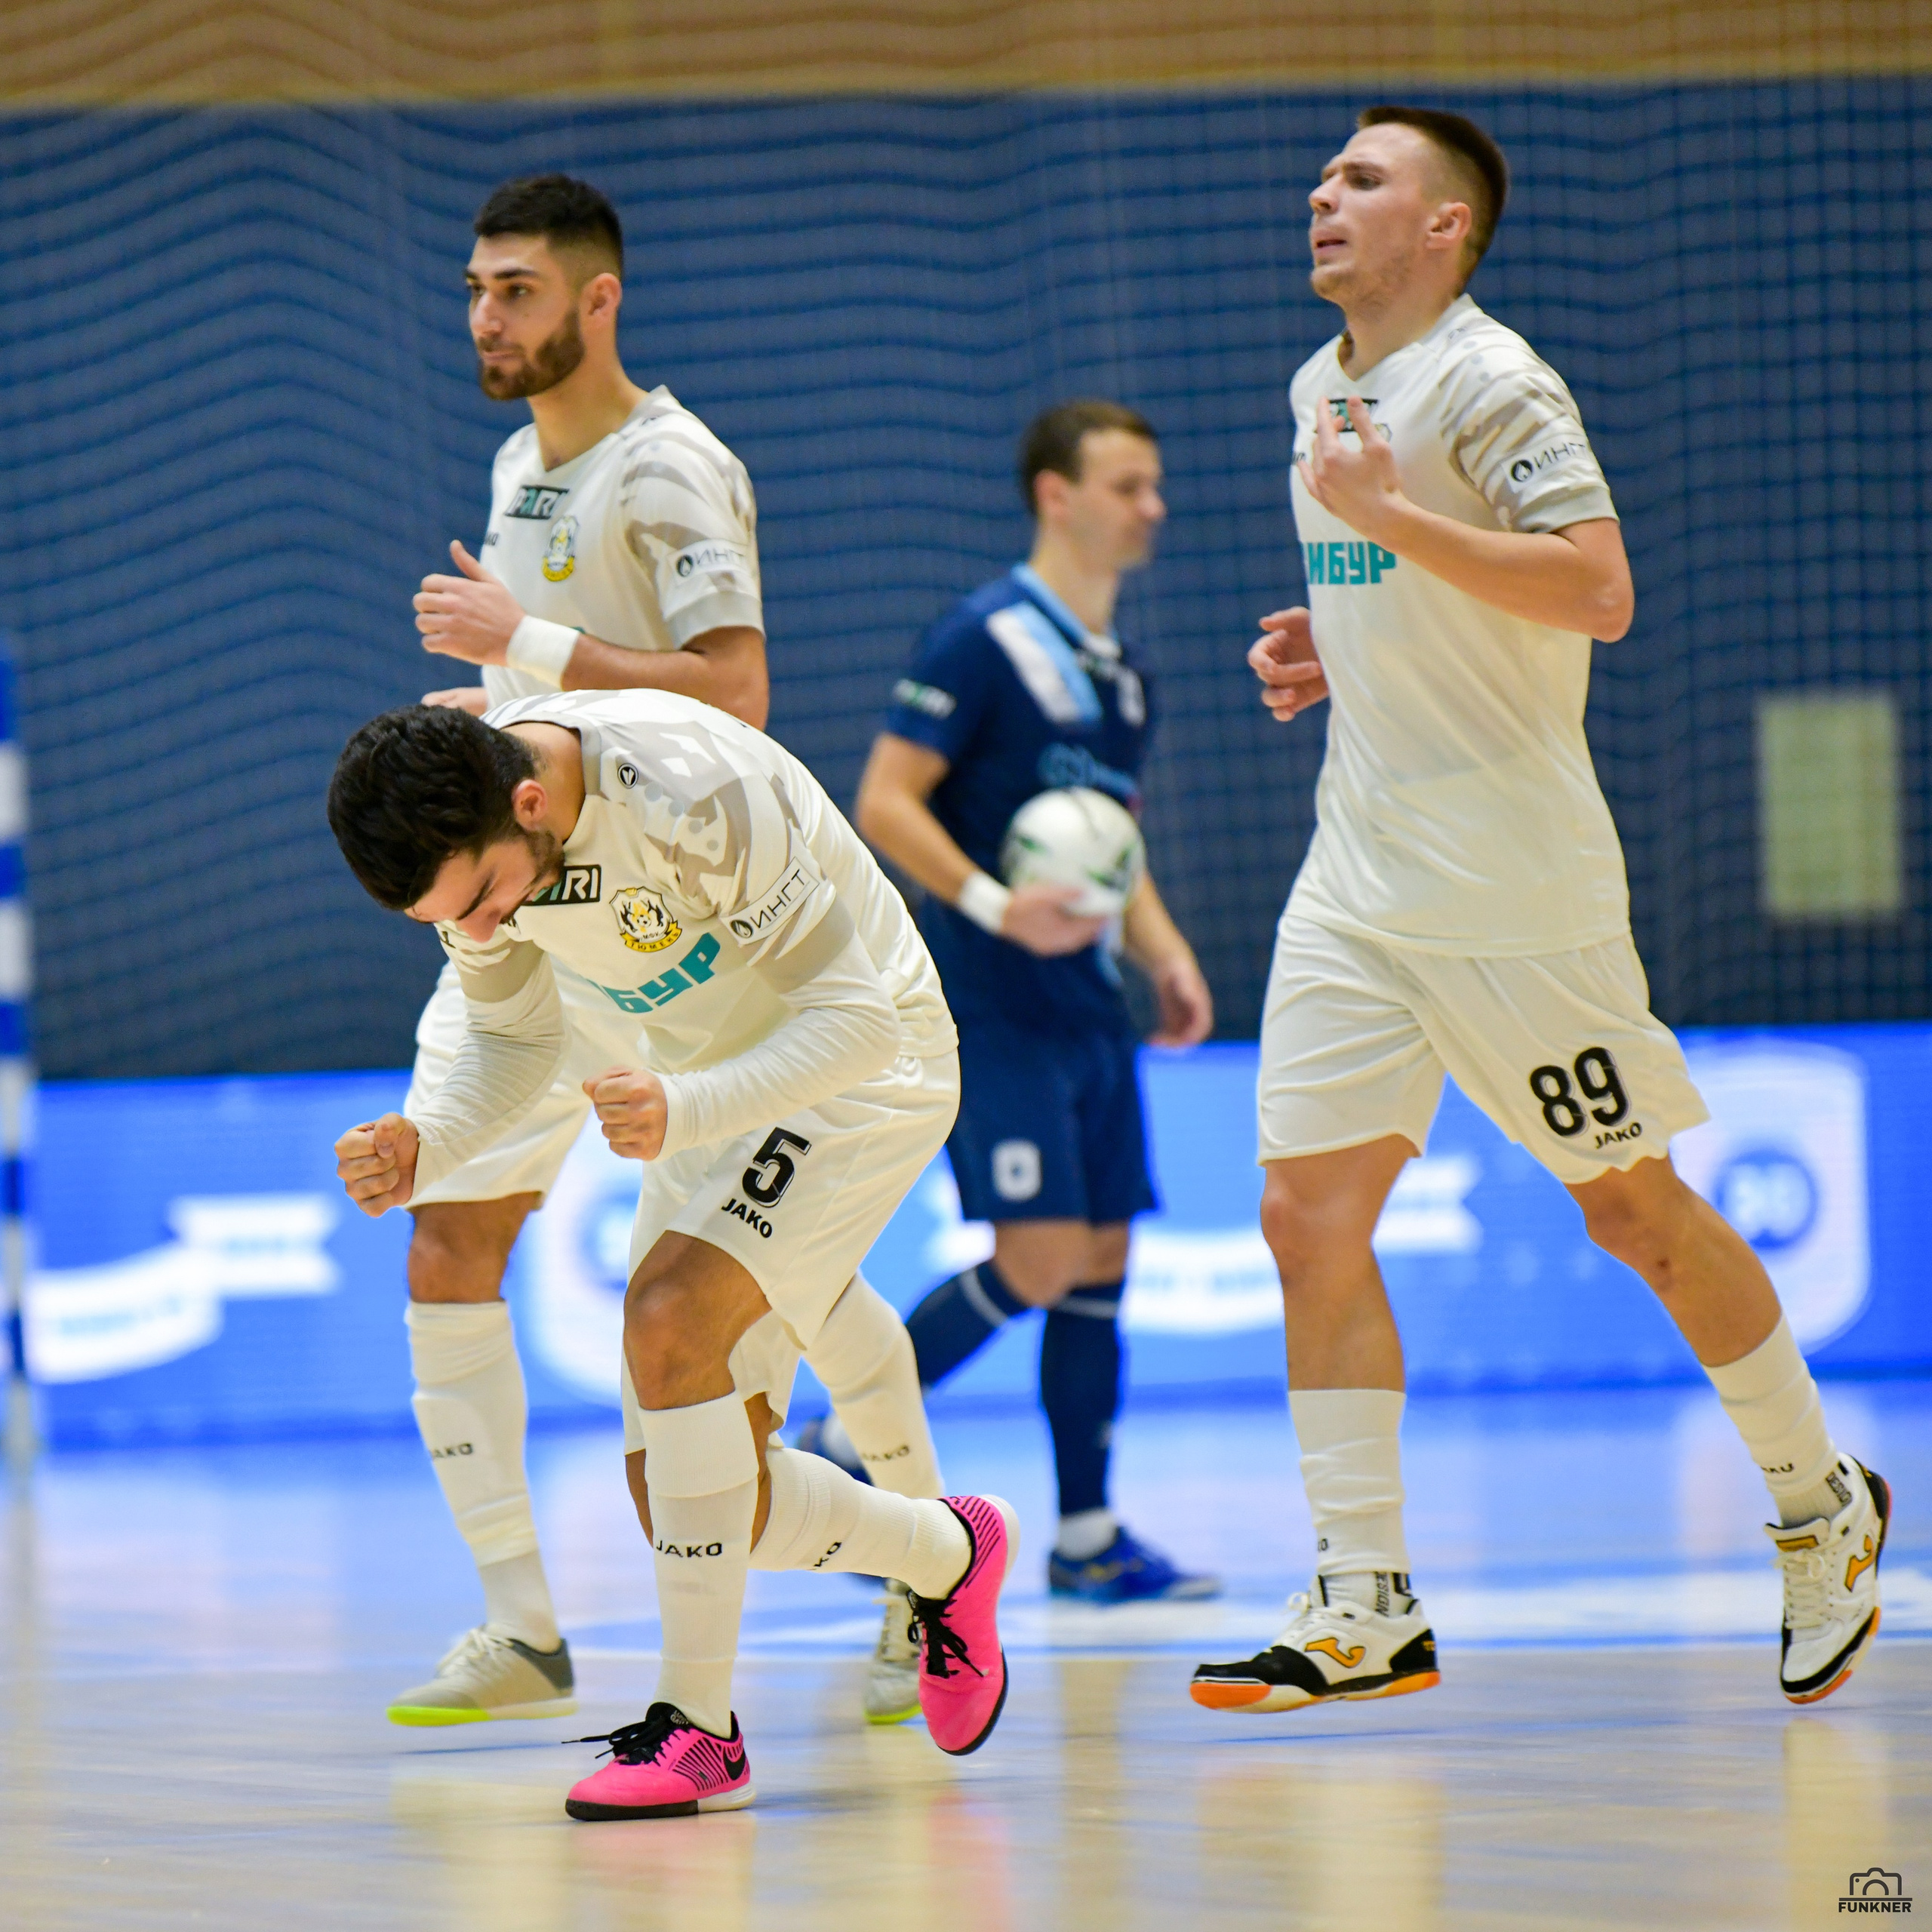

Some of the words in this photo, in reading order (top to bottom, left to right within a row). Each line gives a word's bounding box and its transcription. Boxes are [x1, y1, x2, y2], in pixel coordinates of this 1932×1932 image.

[1306, 541, 1396, 585] ИБУР
[749, 868, 805, 928] ИНГТ
[587, 932, 721, 1014] БУР
[1529, 1046, 1632, 1140] 89
[1594, 1121, 1644, 1149] JAKO
[742, 1126, 813, 1209] 5
[721, 1198, 774, 1239] JAKO
[656, 1540, 722, 1558] JAKO
